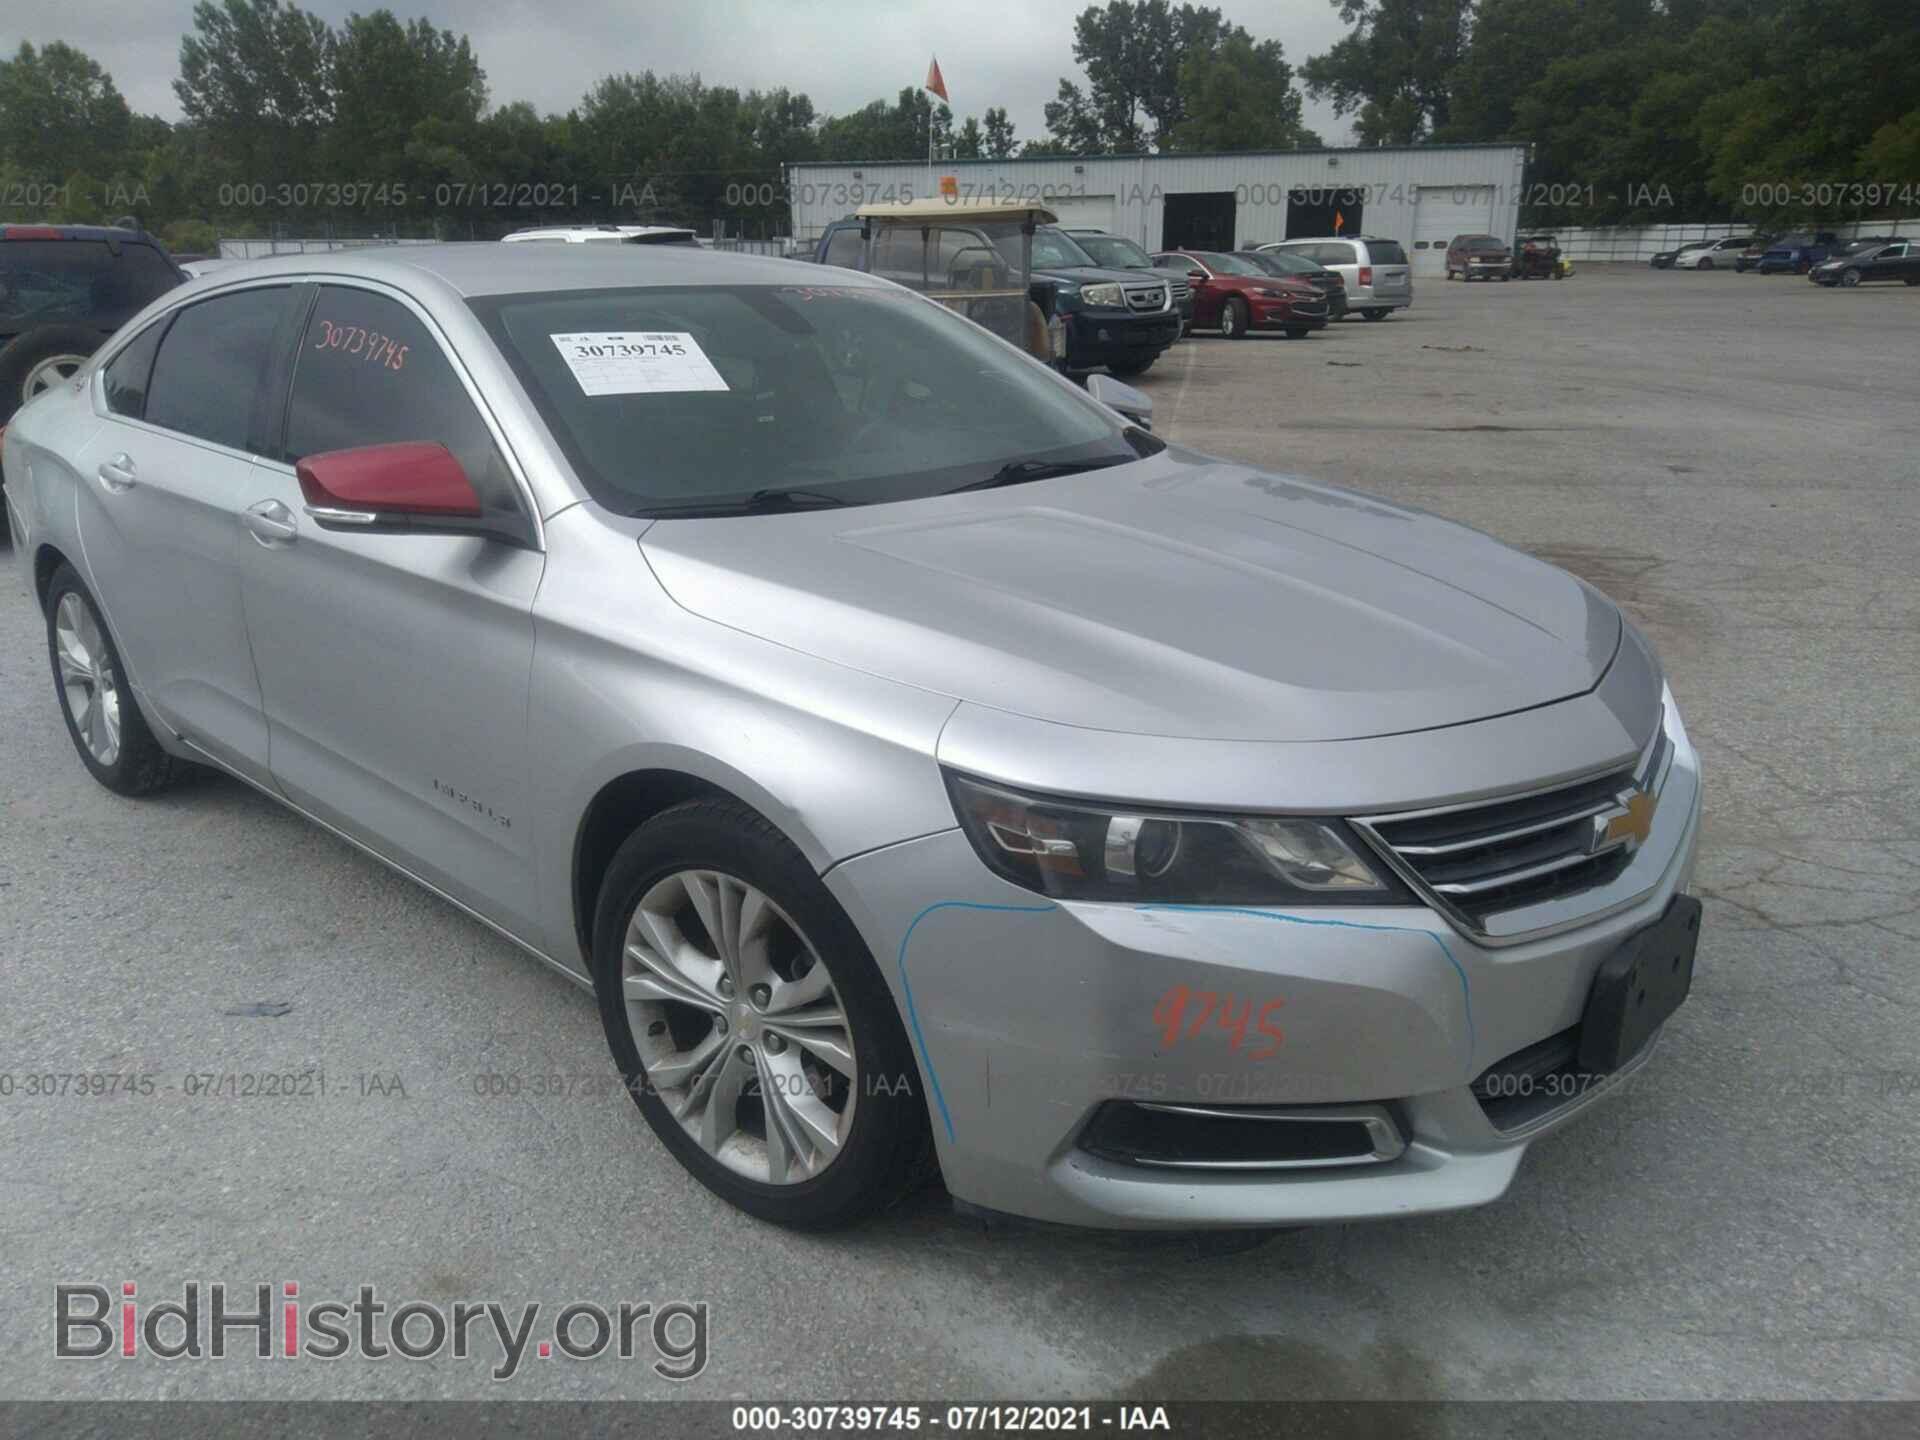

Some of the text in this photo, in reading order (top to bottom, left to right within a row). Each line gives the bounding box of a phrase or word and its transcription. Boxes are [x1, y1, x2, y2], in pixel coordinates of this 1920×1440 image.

[315, 320, 409, 370] 30739745
[574, 343, 687, 358] 30739745
[1153, 983, 1287, 1061] 9745
